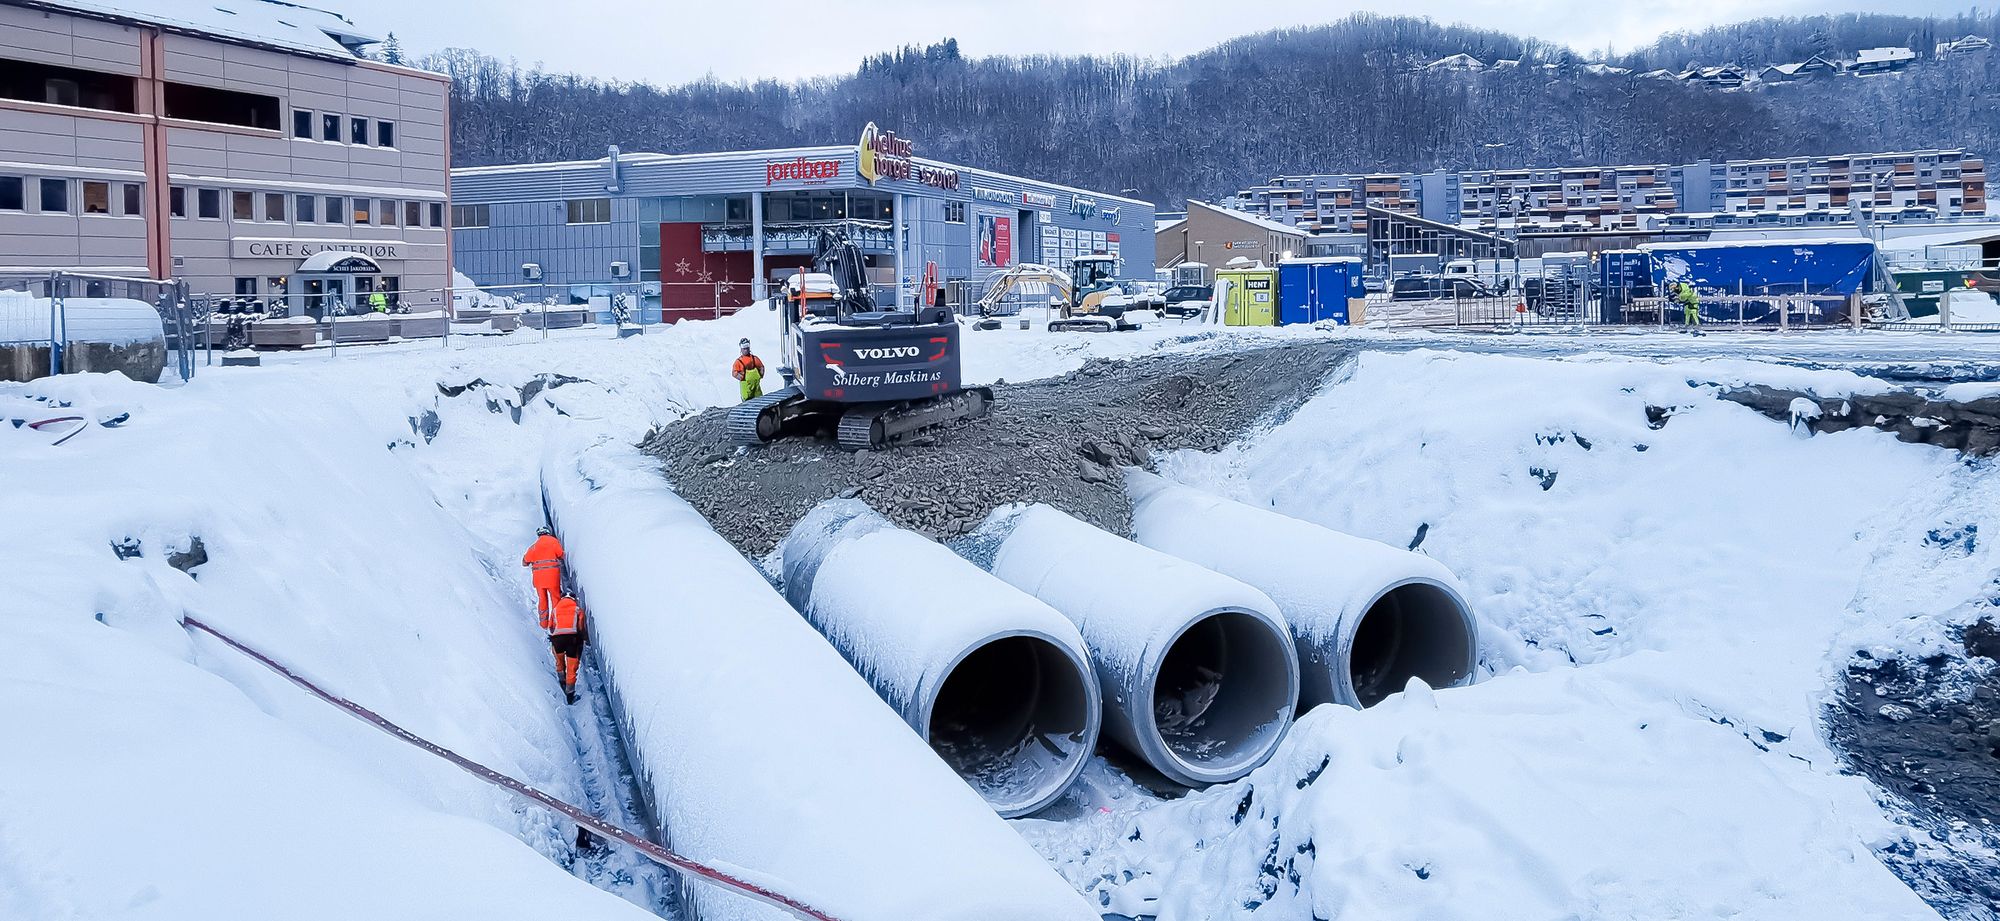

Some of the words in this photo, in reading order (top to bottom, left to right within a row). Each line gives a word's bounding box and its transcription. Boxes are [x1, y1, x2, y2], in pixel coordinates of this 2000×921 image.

[867, 130, 912, 157] Melhus
[766, 157, 840, 186] jordbær
[874, 153, 912, 180] torget
[249, 242, 293, 256] CAFÉ
[300, 244, 312, 256] &
[1247, 281, 1268, 289] HENT
[853, 346, 920, 360] VOLVO
[832, 374, 881, 388] Solberg
[884, 370, 928, 385] Maskin
[930, 371, 942, 382] AS
